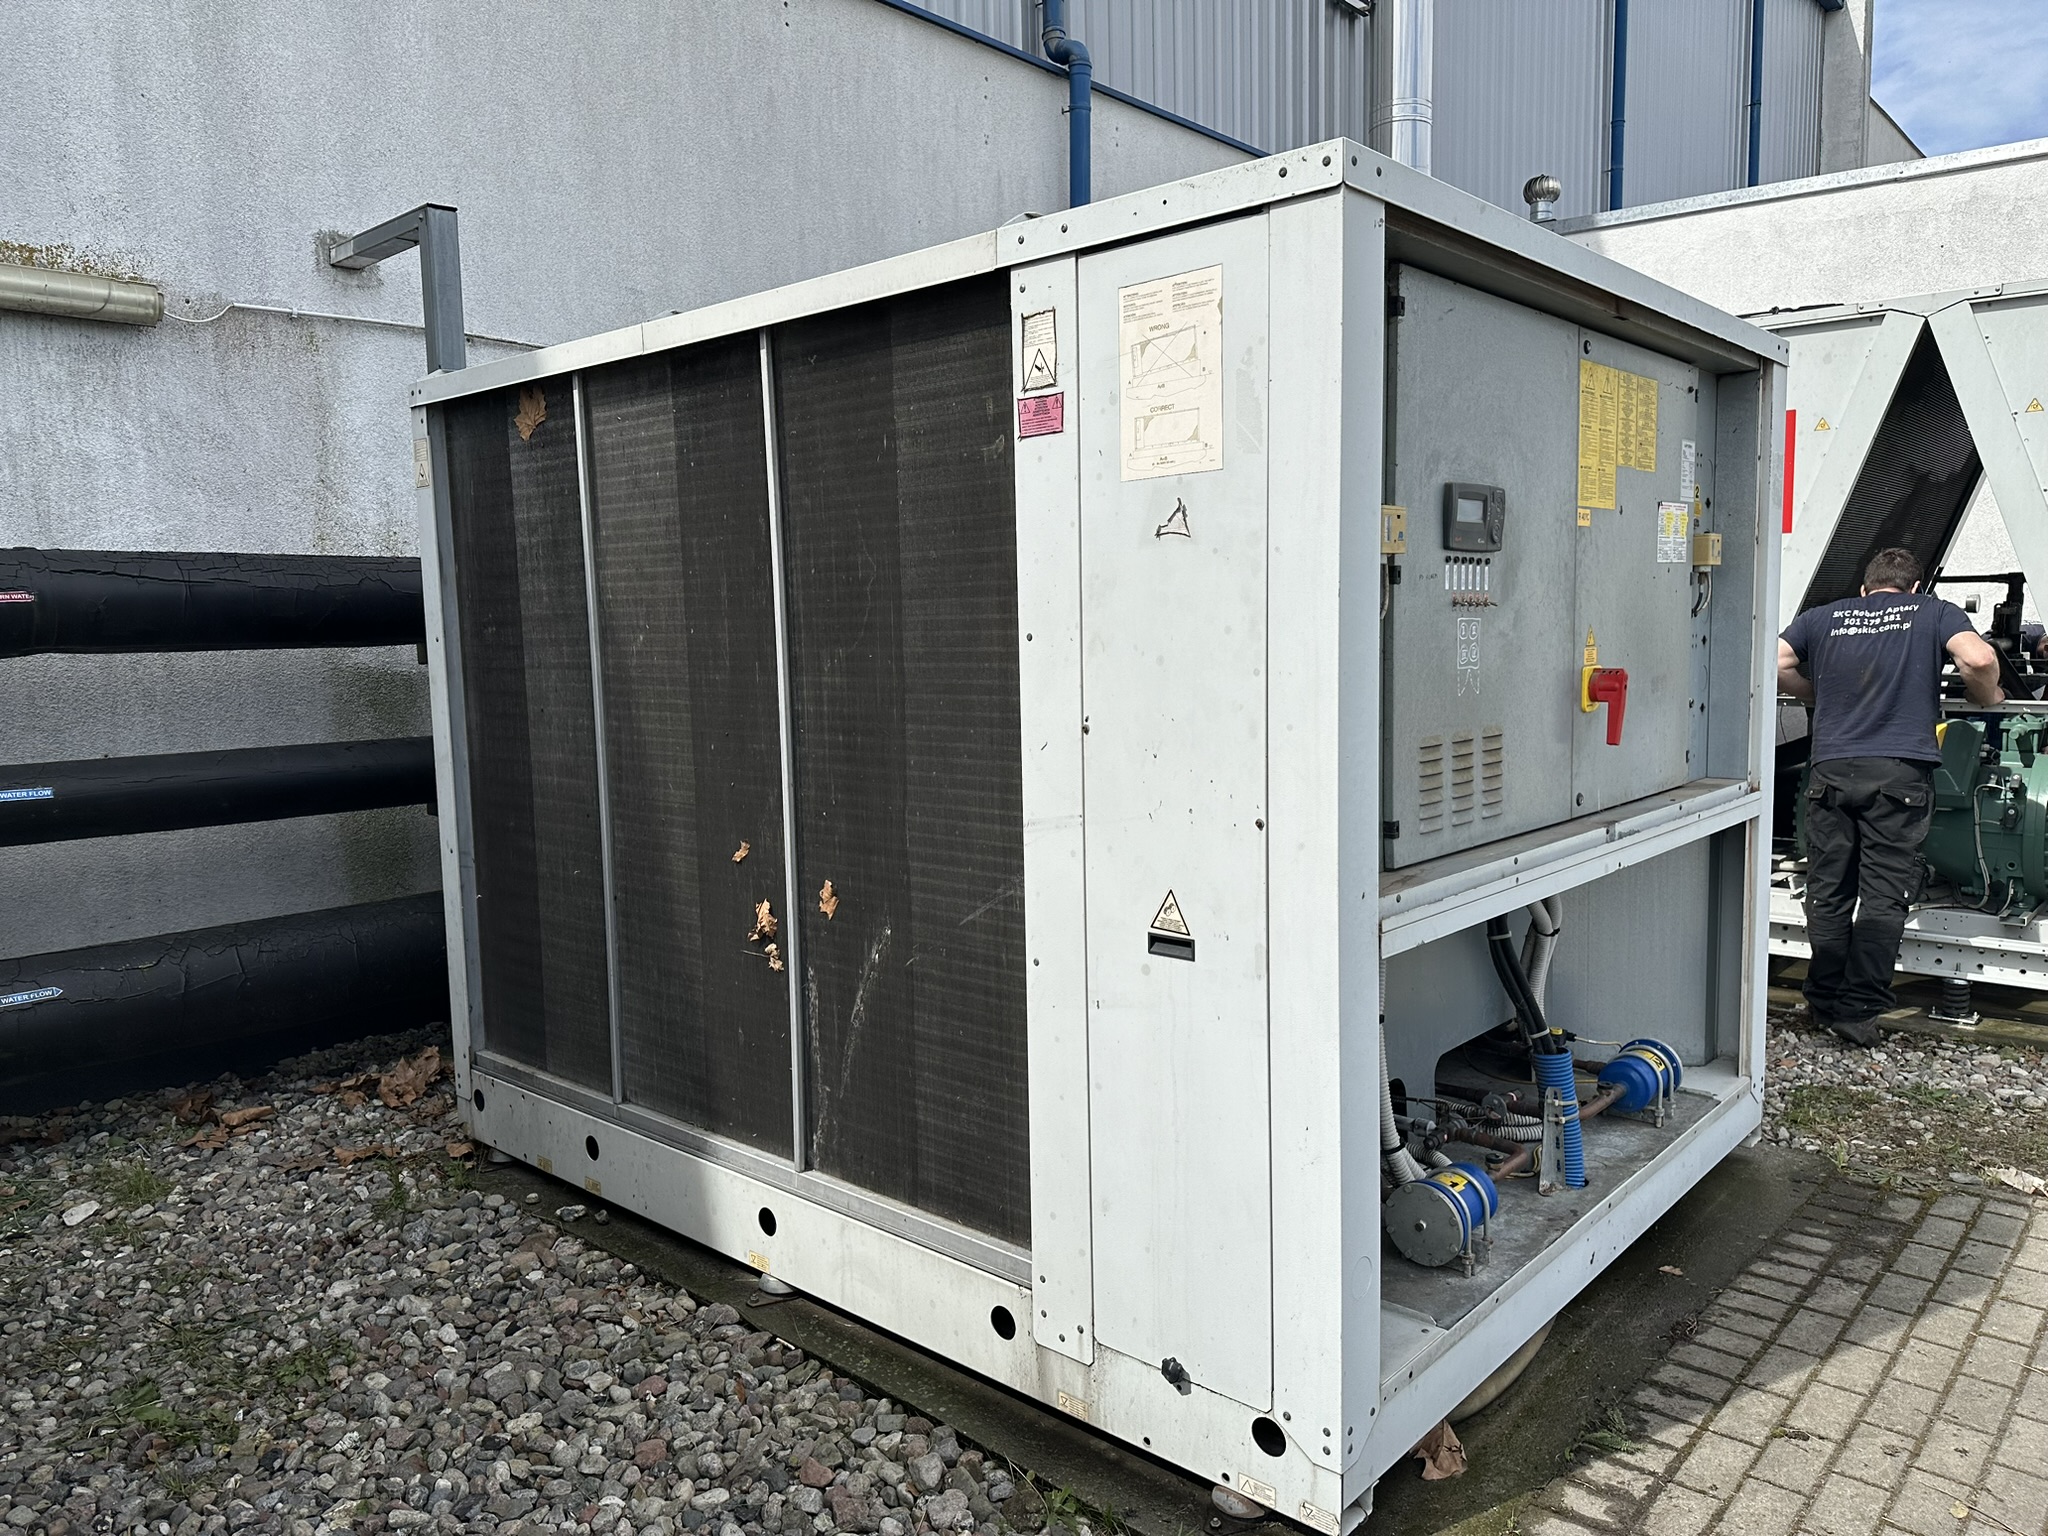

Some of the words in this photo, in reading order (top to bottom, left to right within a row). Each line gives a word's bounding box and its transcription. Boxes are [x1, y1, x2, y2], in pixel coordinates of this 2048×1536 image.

[1149, 322, 1169, 331] WRONG
[1150, 404, 1175, 413] CORRECT
[1695, 485, 1699, 498] 2
[1853, 609, 1883, 618] Robert
[1844, 618, 1861, 626] 501
[1, 995, 29, 1004] WATER
[30, 990, 52, 998] FLOW
